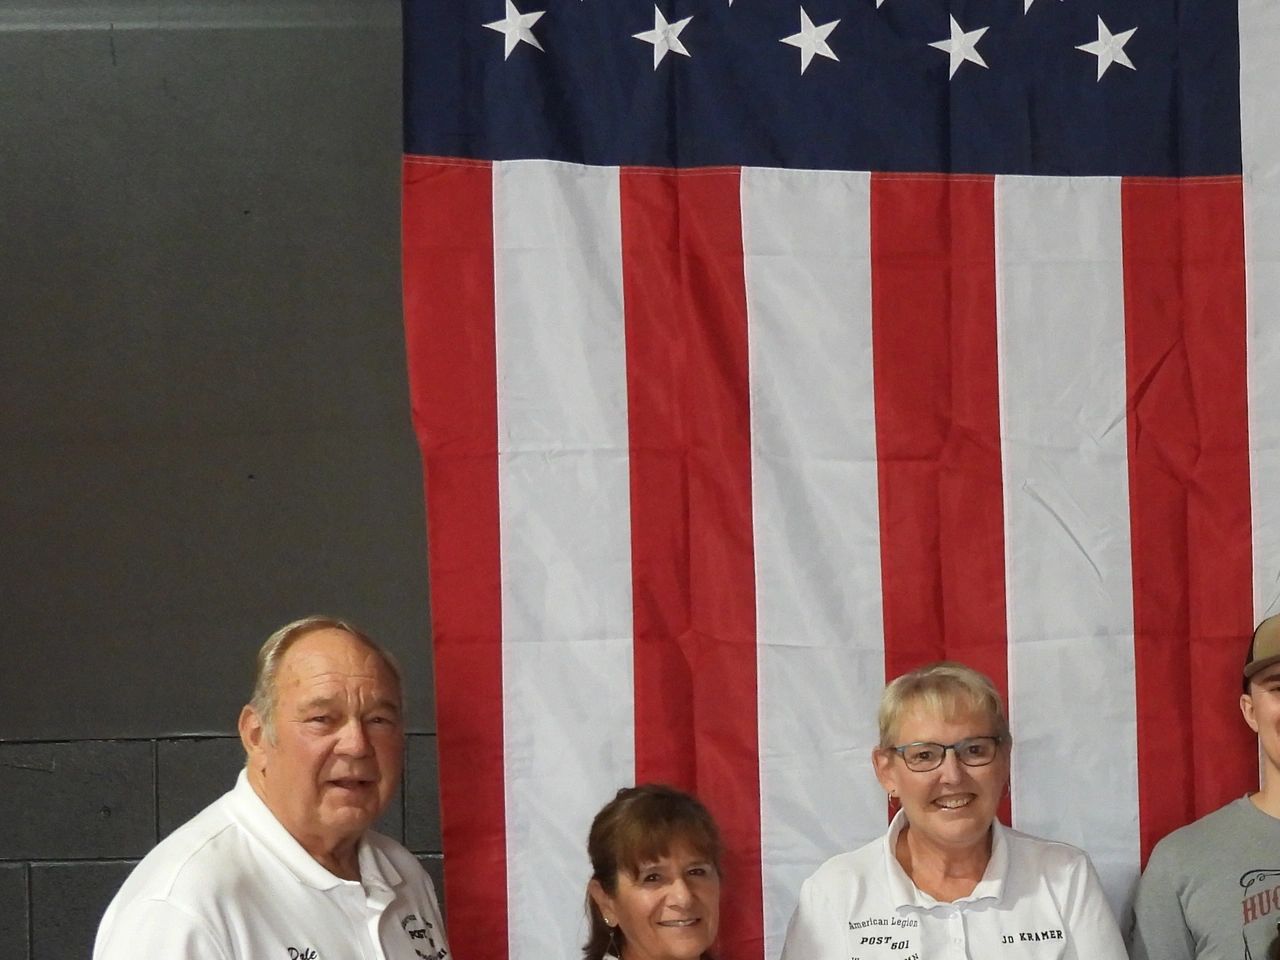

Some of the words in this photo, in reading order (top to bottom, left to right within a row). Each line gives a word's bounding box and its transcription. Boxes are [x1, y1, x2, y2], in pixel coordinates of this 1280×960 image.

[848, 917, 888, 930] American
[891, 917, 918, 928] Legion
[1019, 930, 1063, 941] KRAMER
[860, 936, 892, 945] POST
[891, 940, 909, 950] 501
[288, 947, 317, 960] Dale
